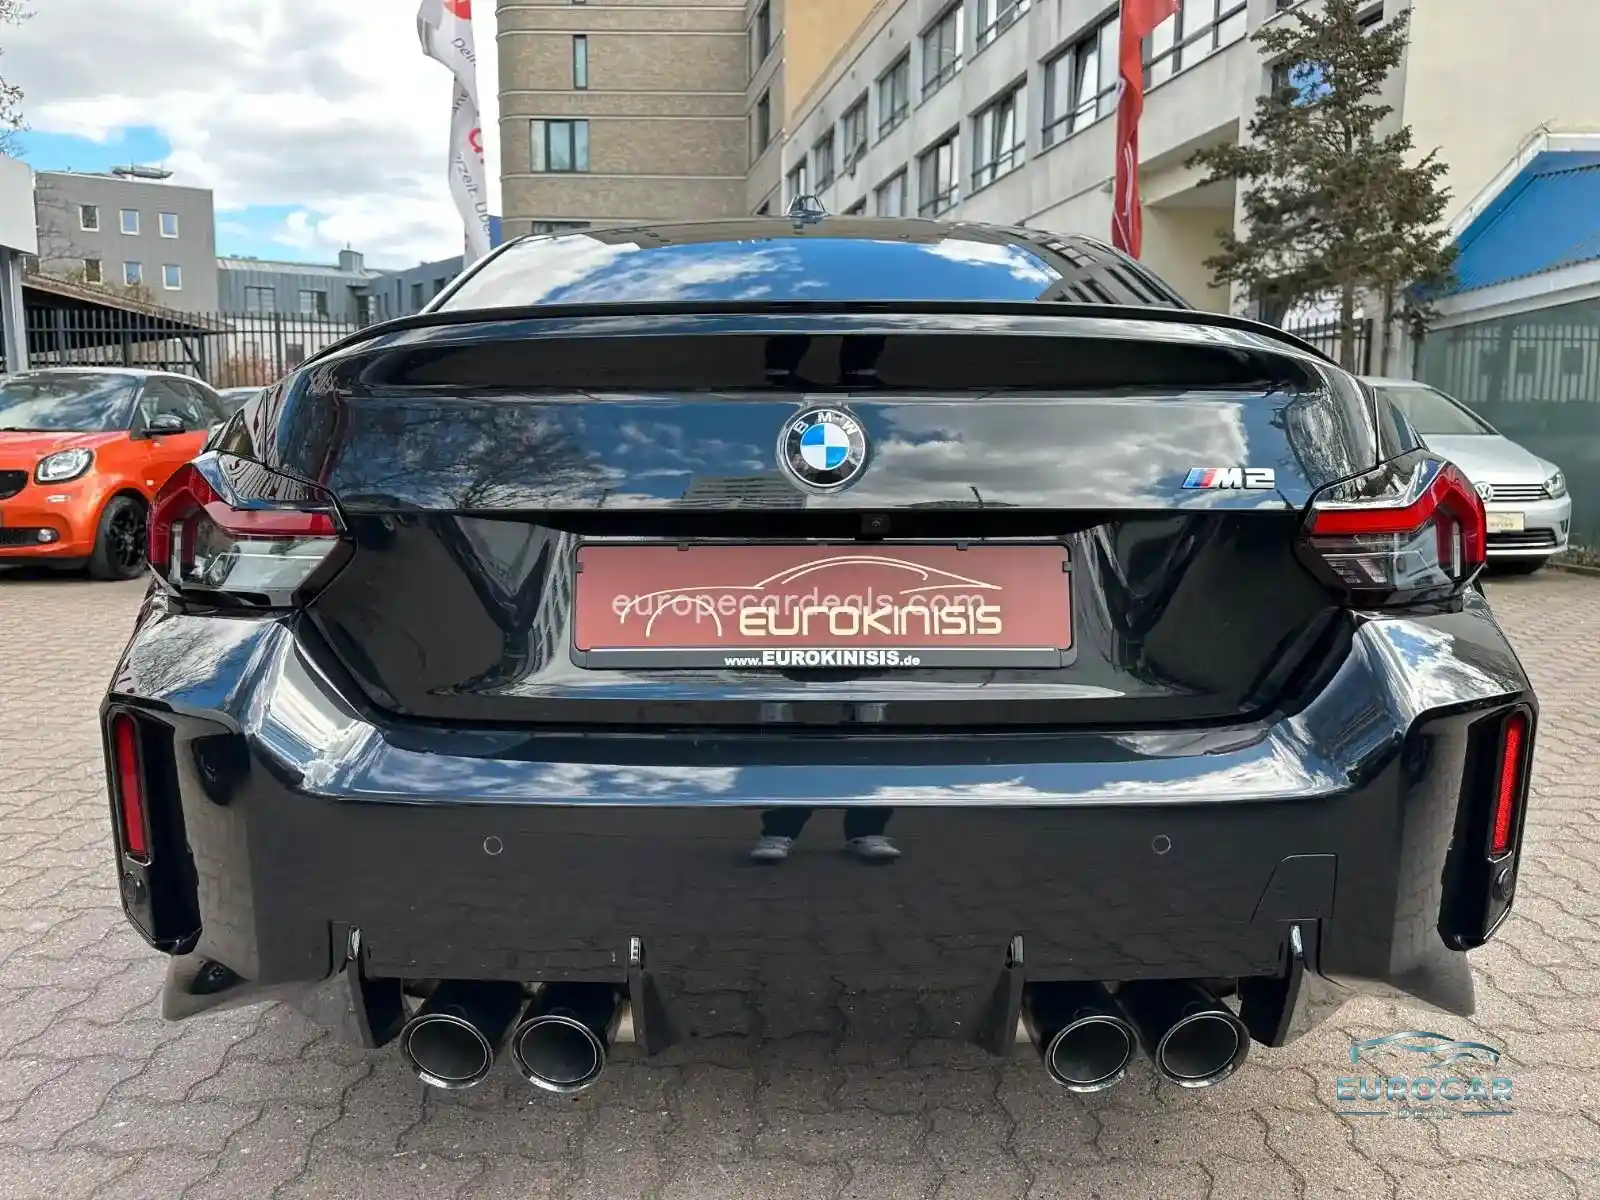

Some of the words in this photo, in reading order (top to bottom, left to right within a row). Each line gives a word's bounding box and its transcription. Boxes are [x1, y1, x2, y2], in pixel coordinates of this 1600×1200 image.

[793, 411, 858, 435] BMW
[1204, 467, 1276, 489] M2
[724, 650, 921, 666] www.EUROKINISIS.de
